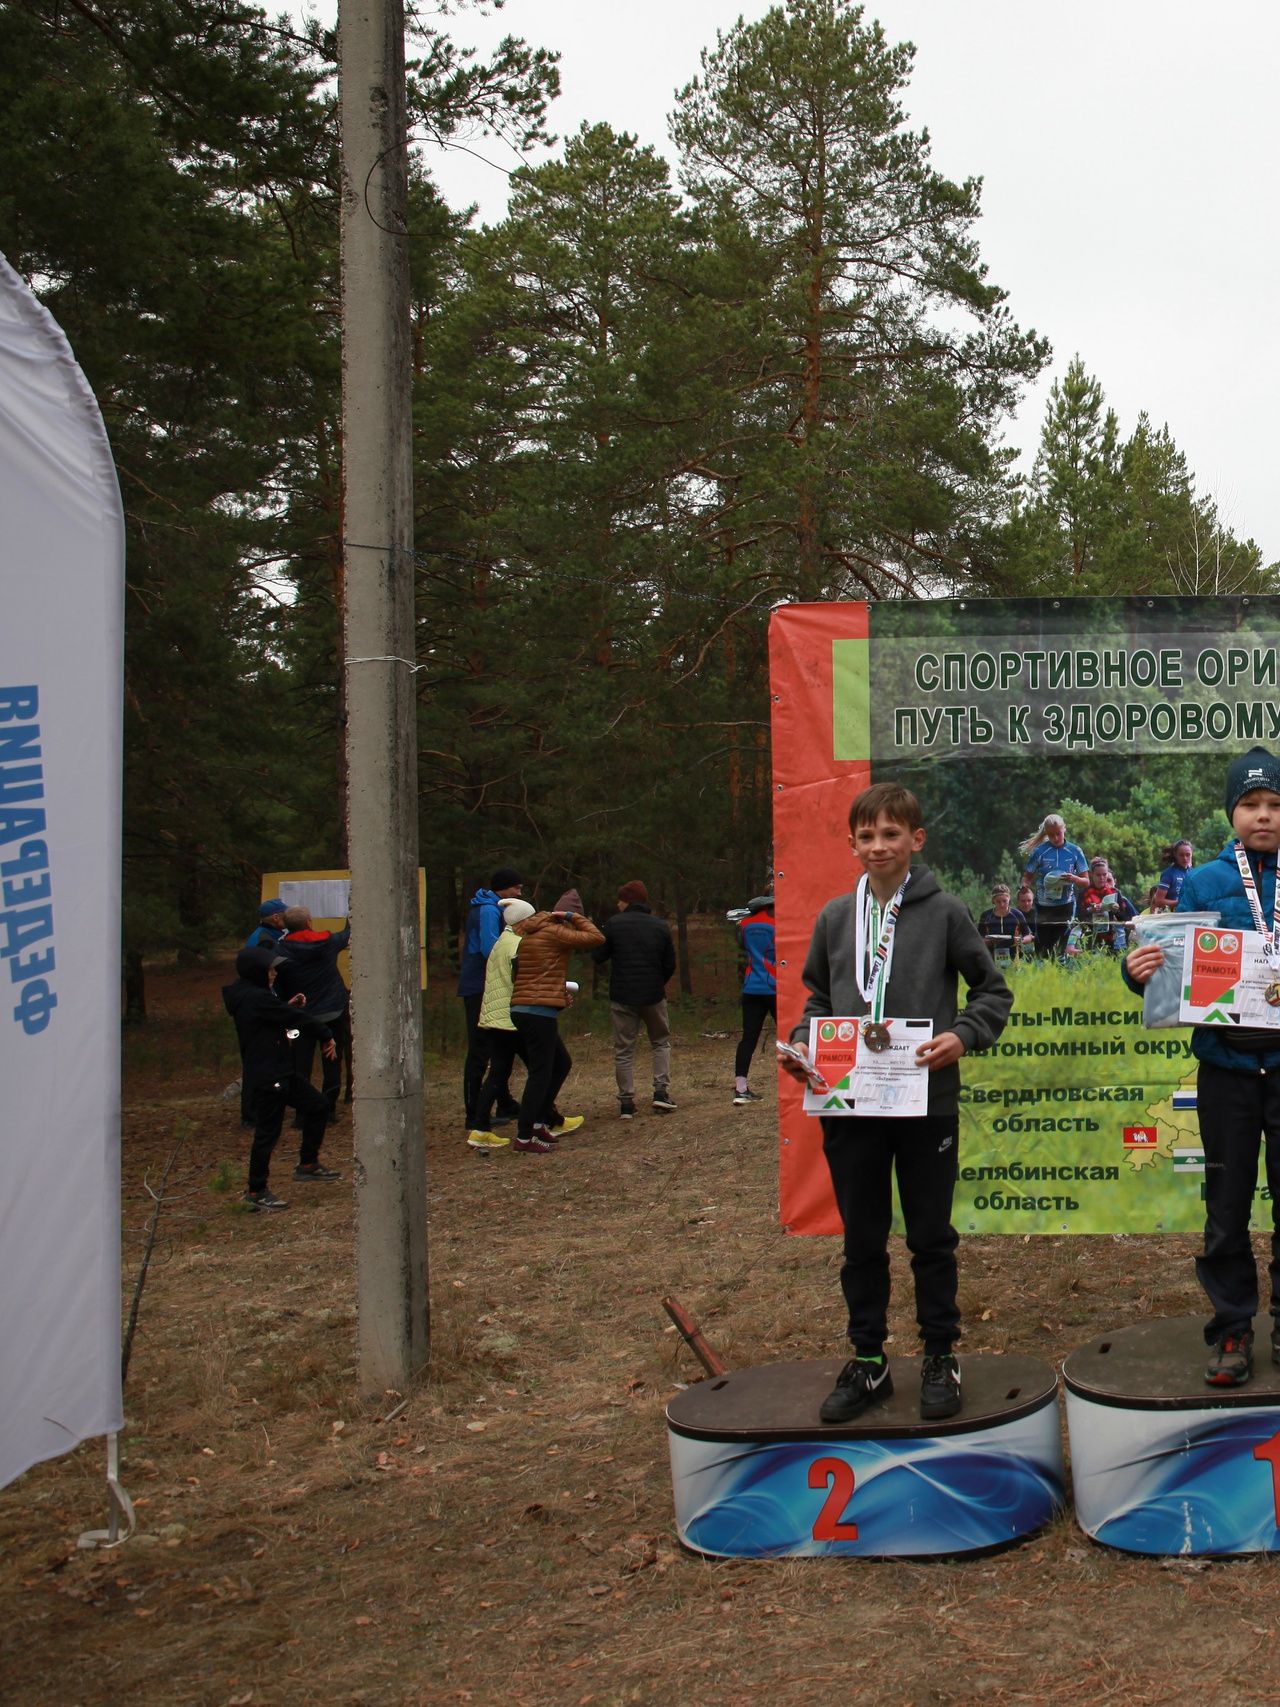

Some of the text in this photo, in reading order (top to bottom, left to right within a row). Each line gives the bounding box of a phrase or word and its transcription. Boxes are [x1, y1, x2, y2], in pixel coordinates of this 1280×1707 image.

[915, 648, 1182, 692] СПОРТИВНОЕ
[894, 706, 993, 747] ПУТЬ
[1008, 705, 1031, 743] К
[1196, 965, 1237, 975] ГРАМОТА
[819, 1054, 853, 1062] ГРАМОТА
[1134, 1038, 1193, 1059] окру
[957, 1085, 1144, 1107] Свердловская
[992, 1113, 1100, 1132] область
[973, 1191, 1080, 1211] область
[807, 1457, 858, 1541] 2
